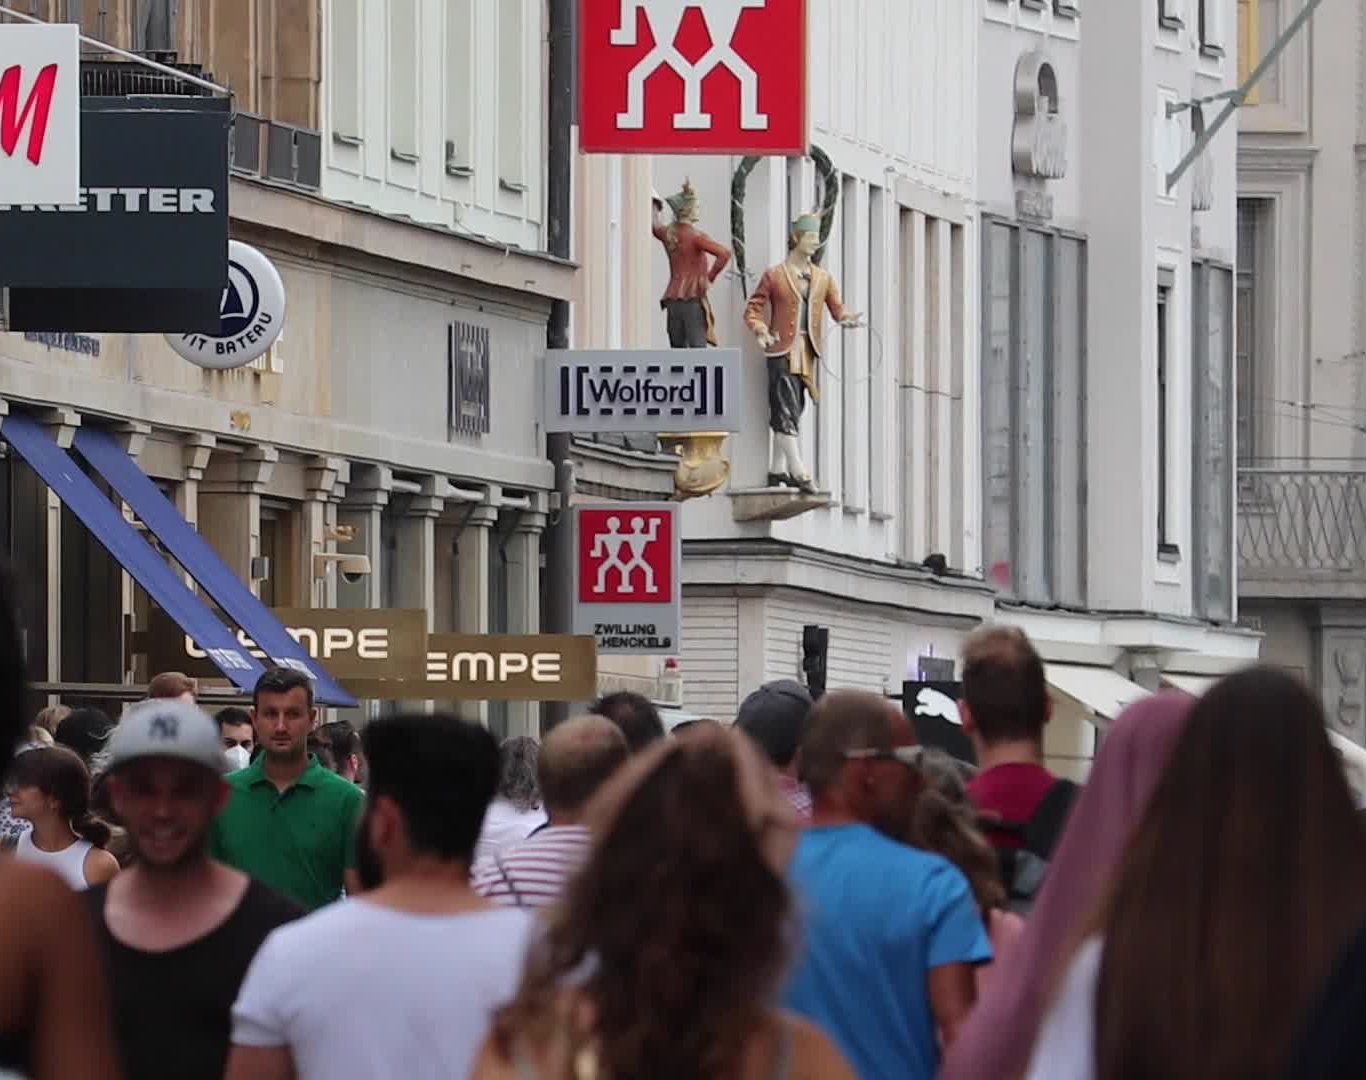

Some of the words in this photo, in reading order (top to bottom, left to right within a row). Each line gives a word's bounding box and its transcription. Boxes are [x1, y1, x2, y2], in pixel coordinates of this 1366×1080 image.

[216, 312, 272, 354] BATEAU
[588, 379, 695, 402] Wolford
[595, 624, 656, 635] ZWILLING
